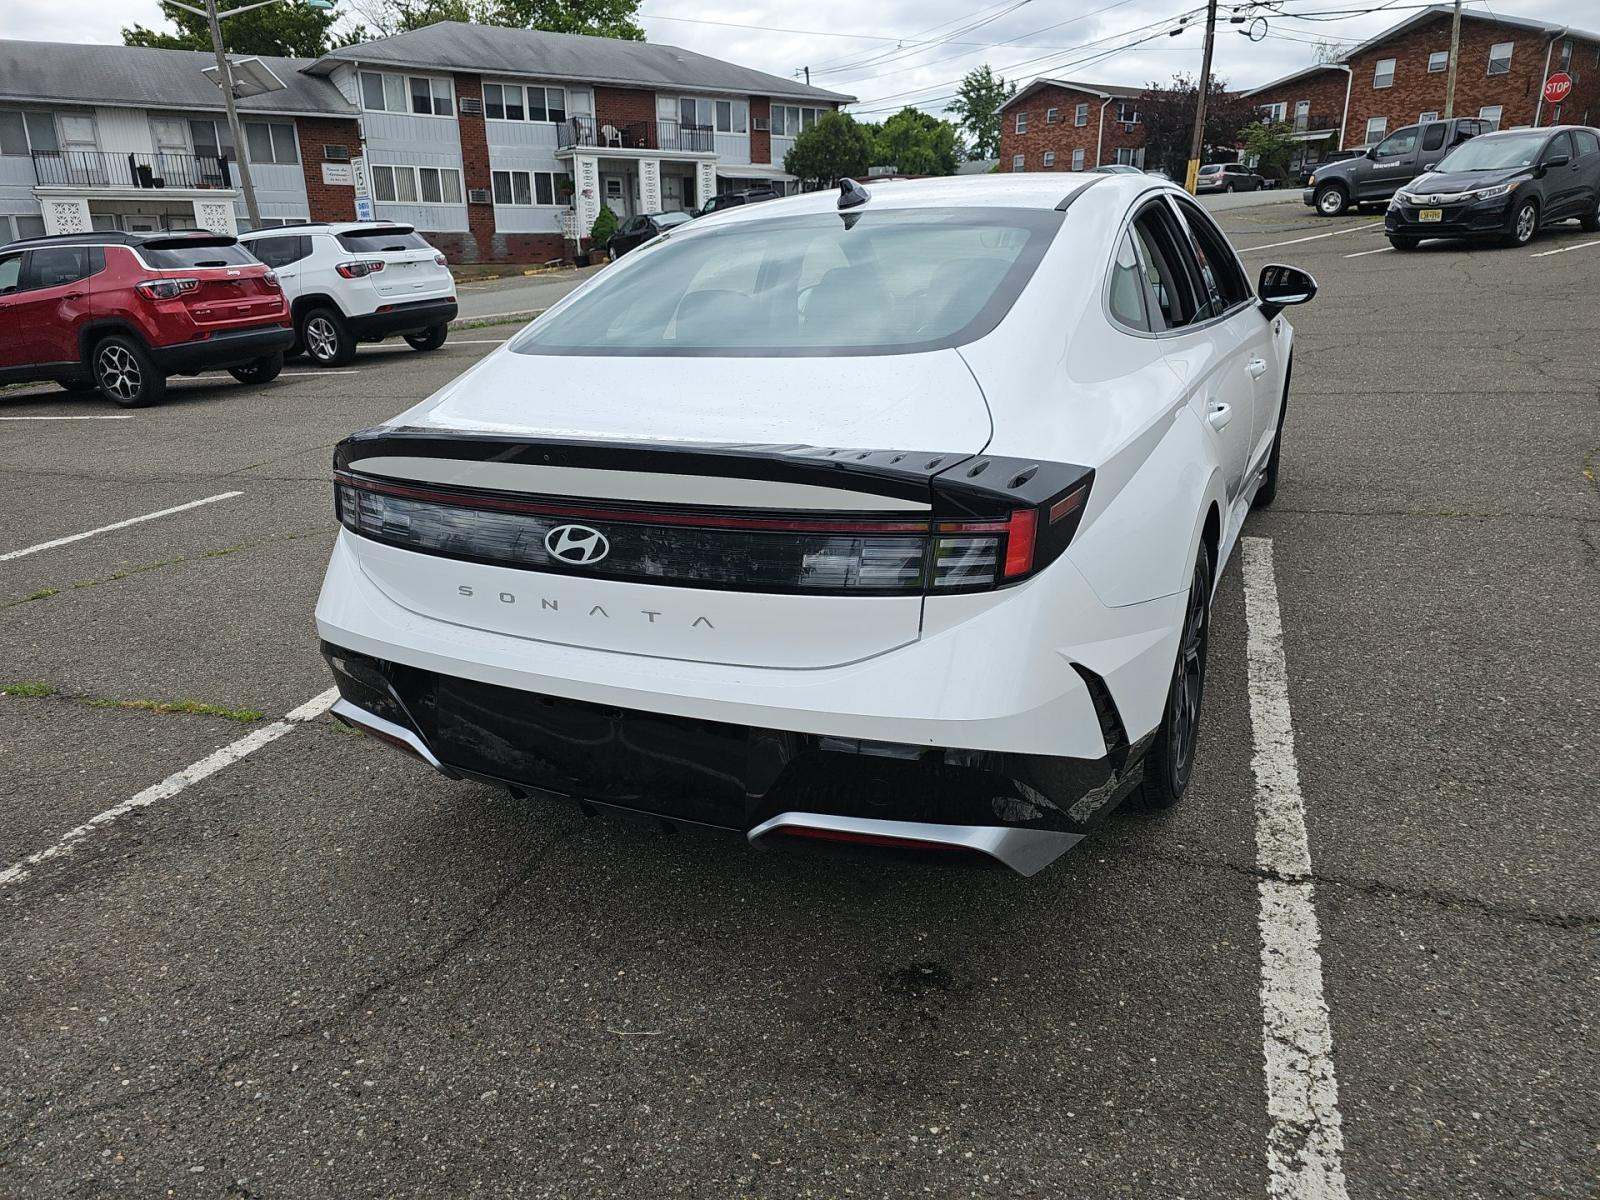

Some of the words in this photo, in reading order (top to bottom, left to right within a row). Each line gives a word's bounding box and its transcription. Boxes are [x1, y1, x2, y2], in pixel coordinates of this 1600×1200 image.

[1545, 82, 1570, 94] STOP
[356, 172, 364, 186] 15
[457, 584, 715, 630] SONATA
